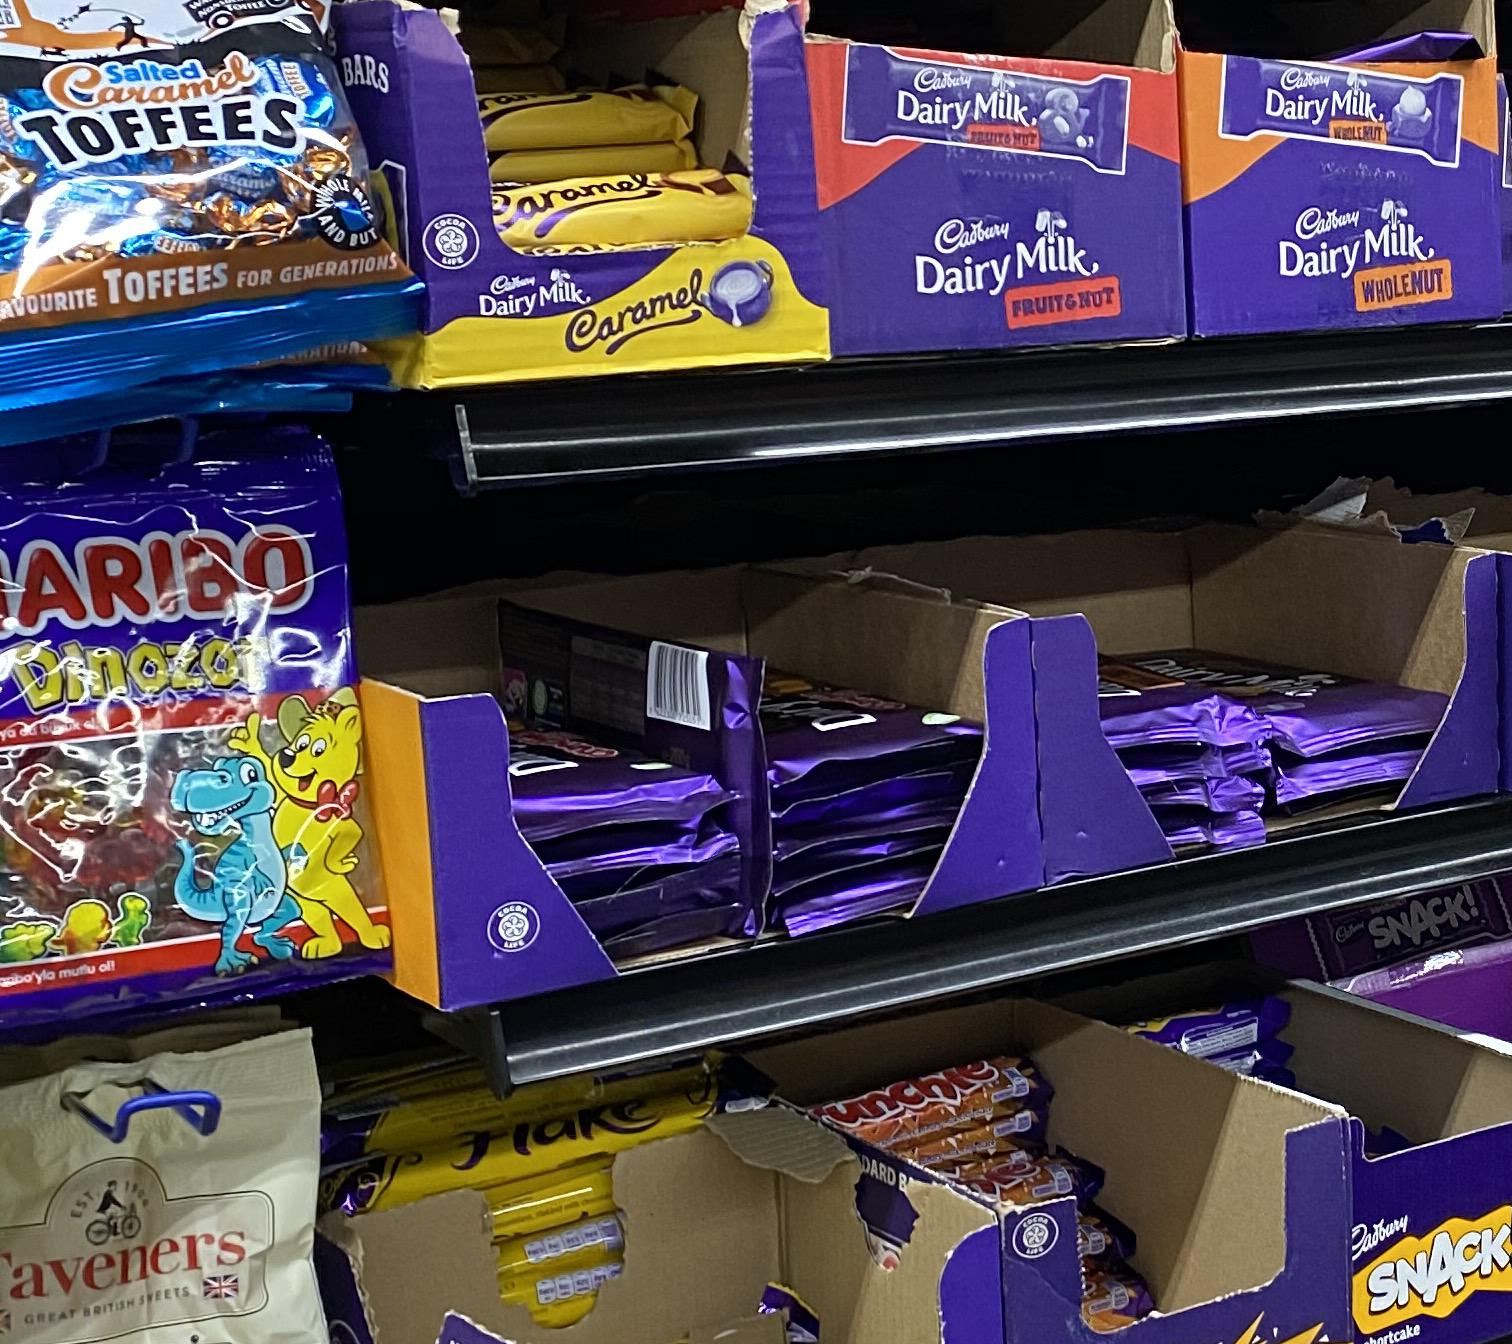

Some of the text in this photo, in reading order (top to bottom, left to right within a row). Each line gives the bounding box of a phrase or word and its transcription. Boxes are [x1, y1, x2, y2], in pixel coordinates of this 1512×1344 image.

[106, 62, 201, 82] Salted
[343, 56, 390, 94] BARS
[913, 68, 973, 94] Cadbury
[1280, 66, 1330, 91] Cadbury
[20, 97, 300, 167] TOFFEES
[935, 218, 1010, 254] Cadbury
[1279, 227, 1434, 280] Dairy Milk
[102, 263, 229, 304] TOFFEES
[236, 269, 273, 288] FOR
[279, 253, 398, 285] GENERATIONS
[915, 241, 1099, 296] Dairy Milk
[1361, 265, 1446, 306] WHOLENUT
[479, 281, 591, 317] Dairy Milk
[565, 269, 705, 354] Caramel
[1012, 287, 1115, 319] FRUIT&NUT
[24, 1307, 76, 1327] GREAT
[83, 1300, 134, 1318] BRITISH
